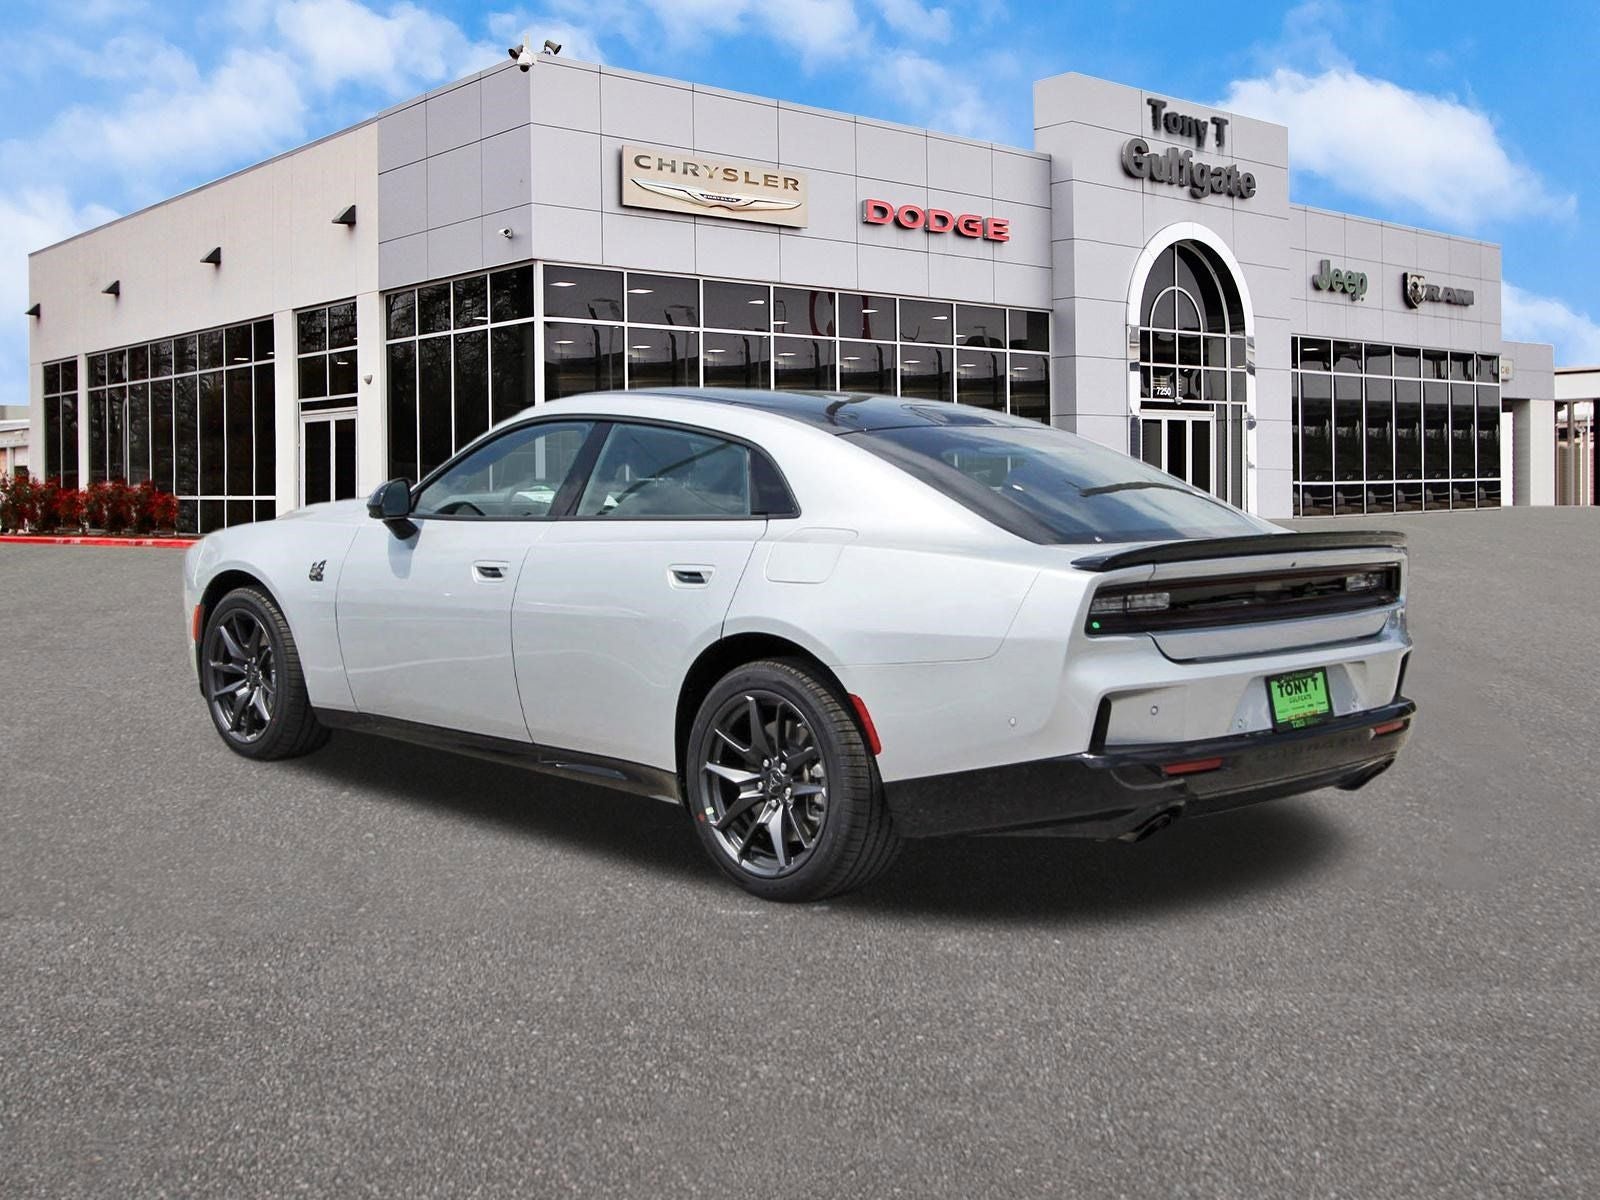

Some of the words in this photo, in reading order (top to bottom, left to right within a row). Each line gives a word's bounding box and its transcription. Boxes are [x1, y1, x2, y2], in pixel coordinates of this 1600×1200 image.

[1147, 98, 1208, 147] Tony
[1211, 116, 1229, 147] T
[634, 154, 799, 192] CHRYSLER
[1121, 138, 1256, 199] Gulfgate
[863, 198, 1010, 242] DODGE
[1313, 260, 1368, 302] Jeep
[1425, 284, 1474, 306] RAM
[1156, 386, 1172, 396] 7250
[1277, 679, 1309, 698] TONY
[1311, 677, 1319, 691] T
